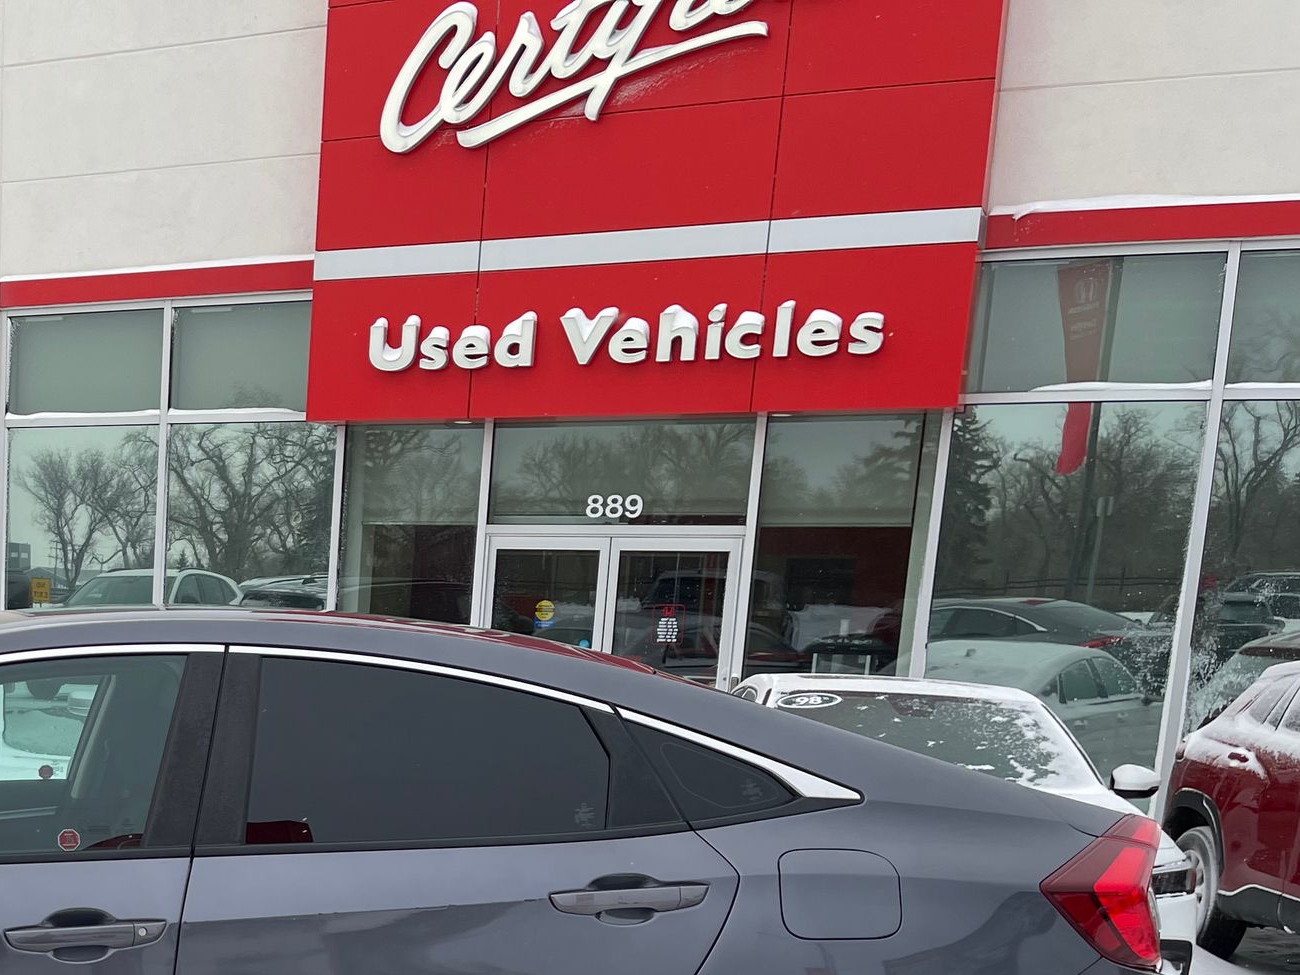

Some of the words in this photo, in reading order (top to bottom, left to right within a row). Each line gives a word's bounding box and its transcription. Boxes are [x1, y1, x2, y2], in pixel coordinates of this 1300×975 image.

[369, 310, 538, 372] Used
[560, 300, 885, 366] Vehicles
[586, 494, 644, 518] 889
